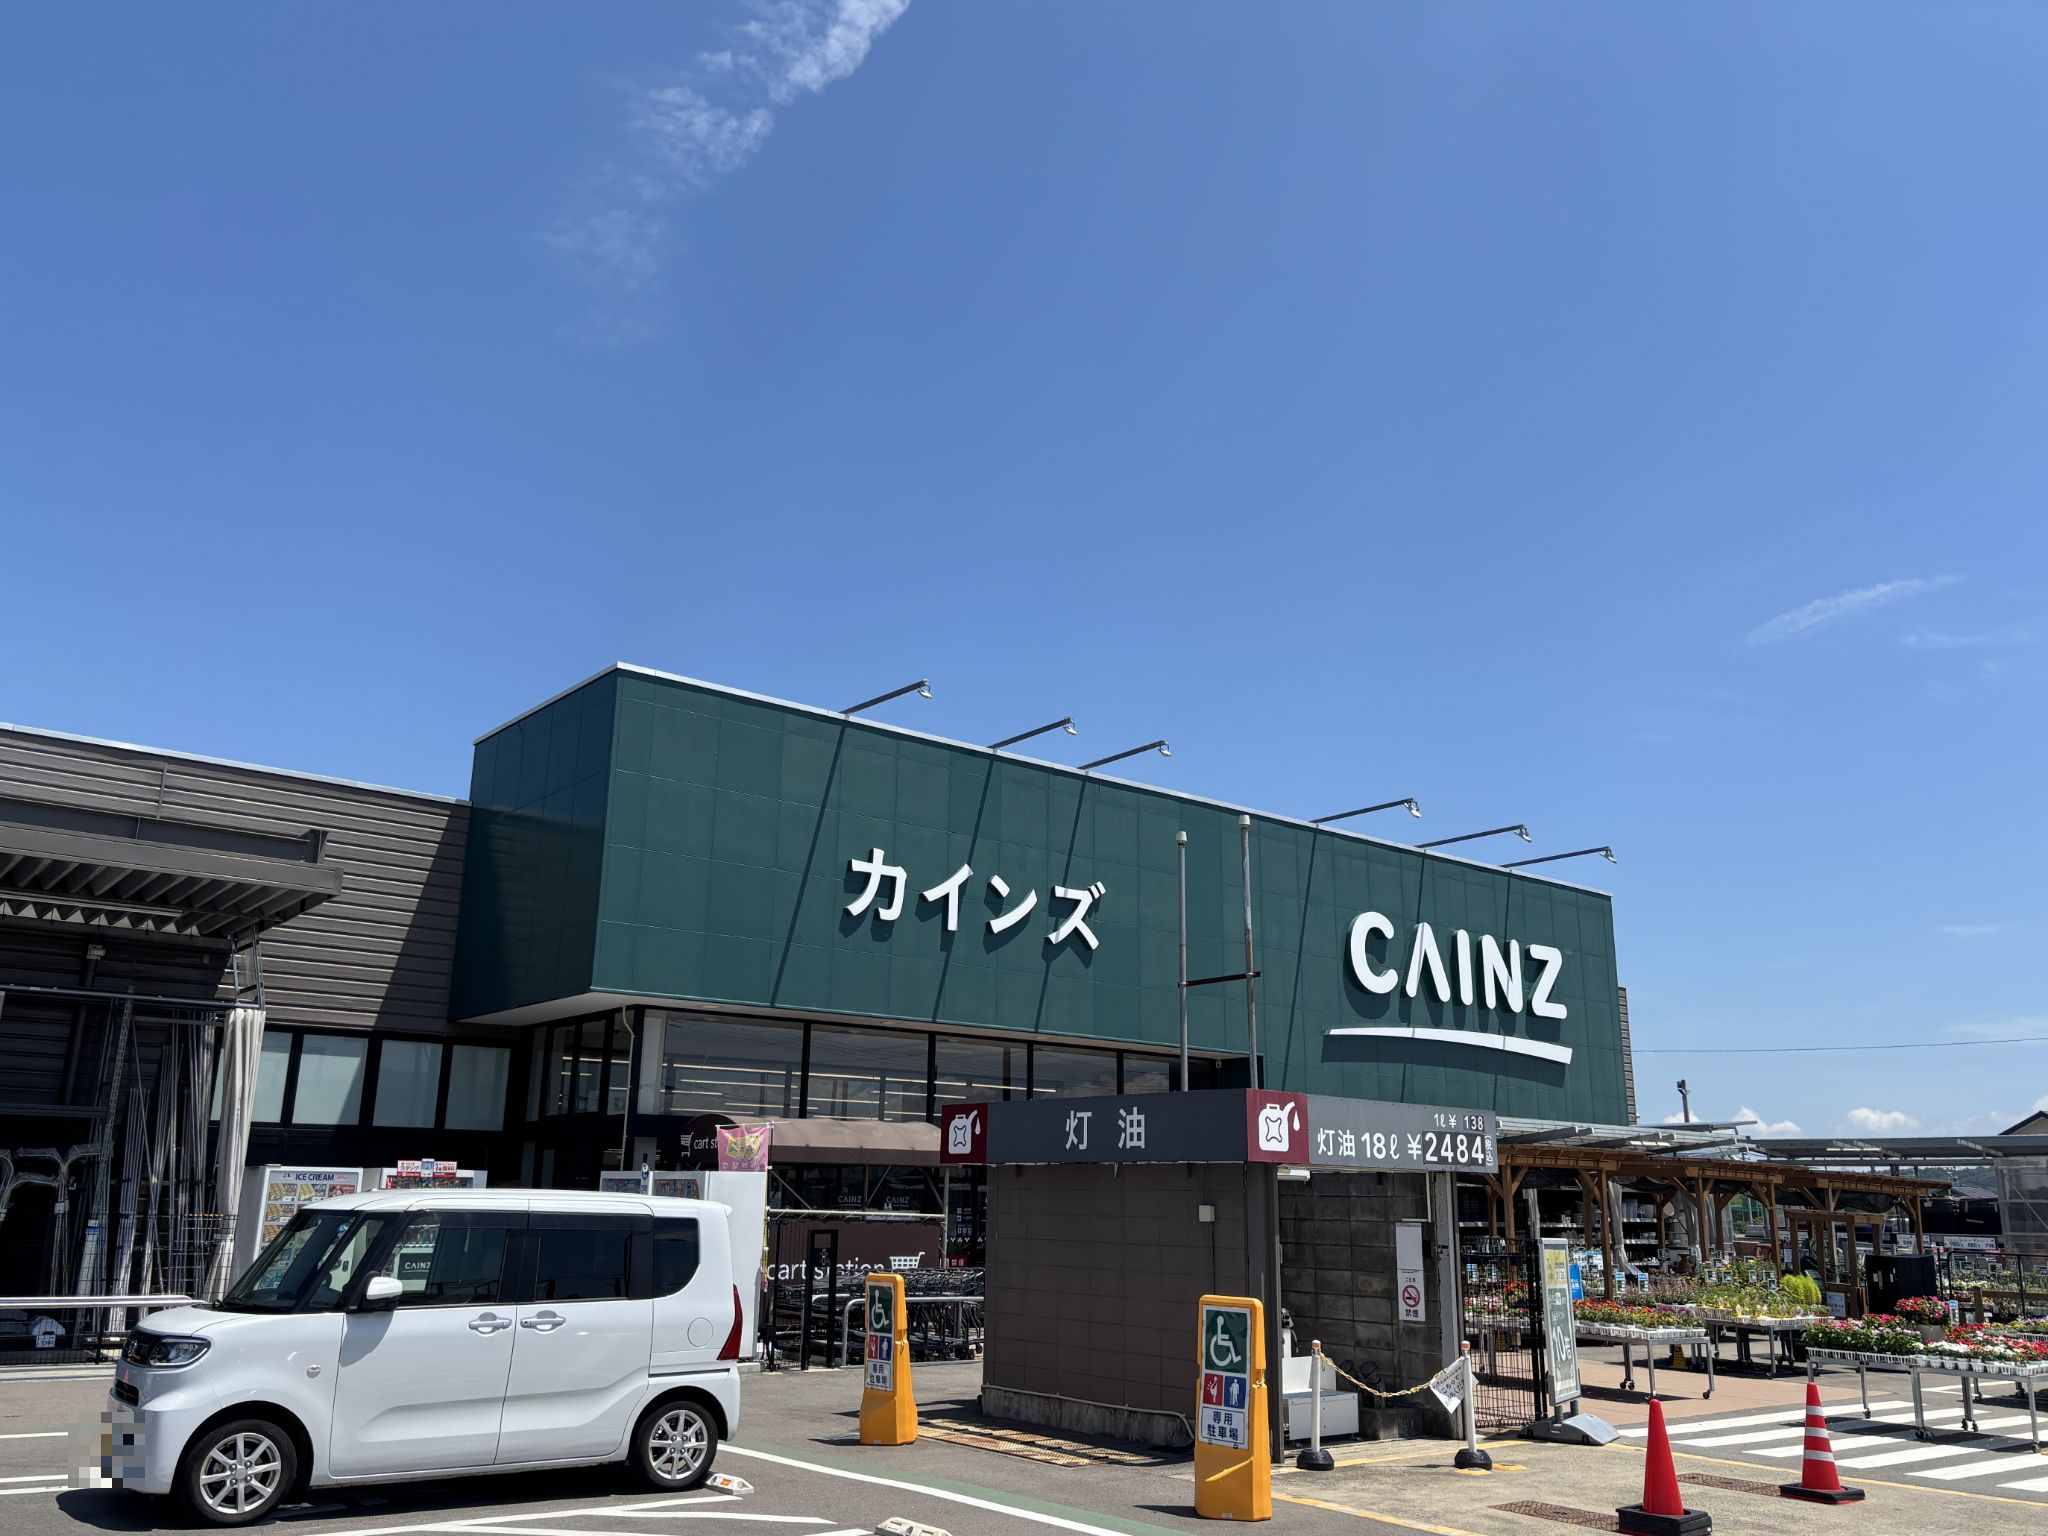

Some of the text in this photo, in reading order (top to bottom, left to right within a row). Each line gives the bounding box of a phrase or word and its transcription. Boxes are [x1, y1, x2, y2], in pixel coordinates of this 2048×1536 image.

[844, 848, 1106, 950] カインズ
[1351, 911, 1568, 1019] CAINZ
[694, 1139, 708, 1149] cart
[1317, 1128, 1356, 1157] 灯油
[295, 1173, 307, 1181] ICE
[308, 1173, 335, 1181] CREAM
[766, 1260, 807, 1280] cart
[1212, 1411, 1233, 1426] 専用
[1207, 1424, 1239, 1441] 駐車場
